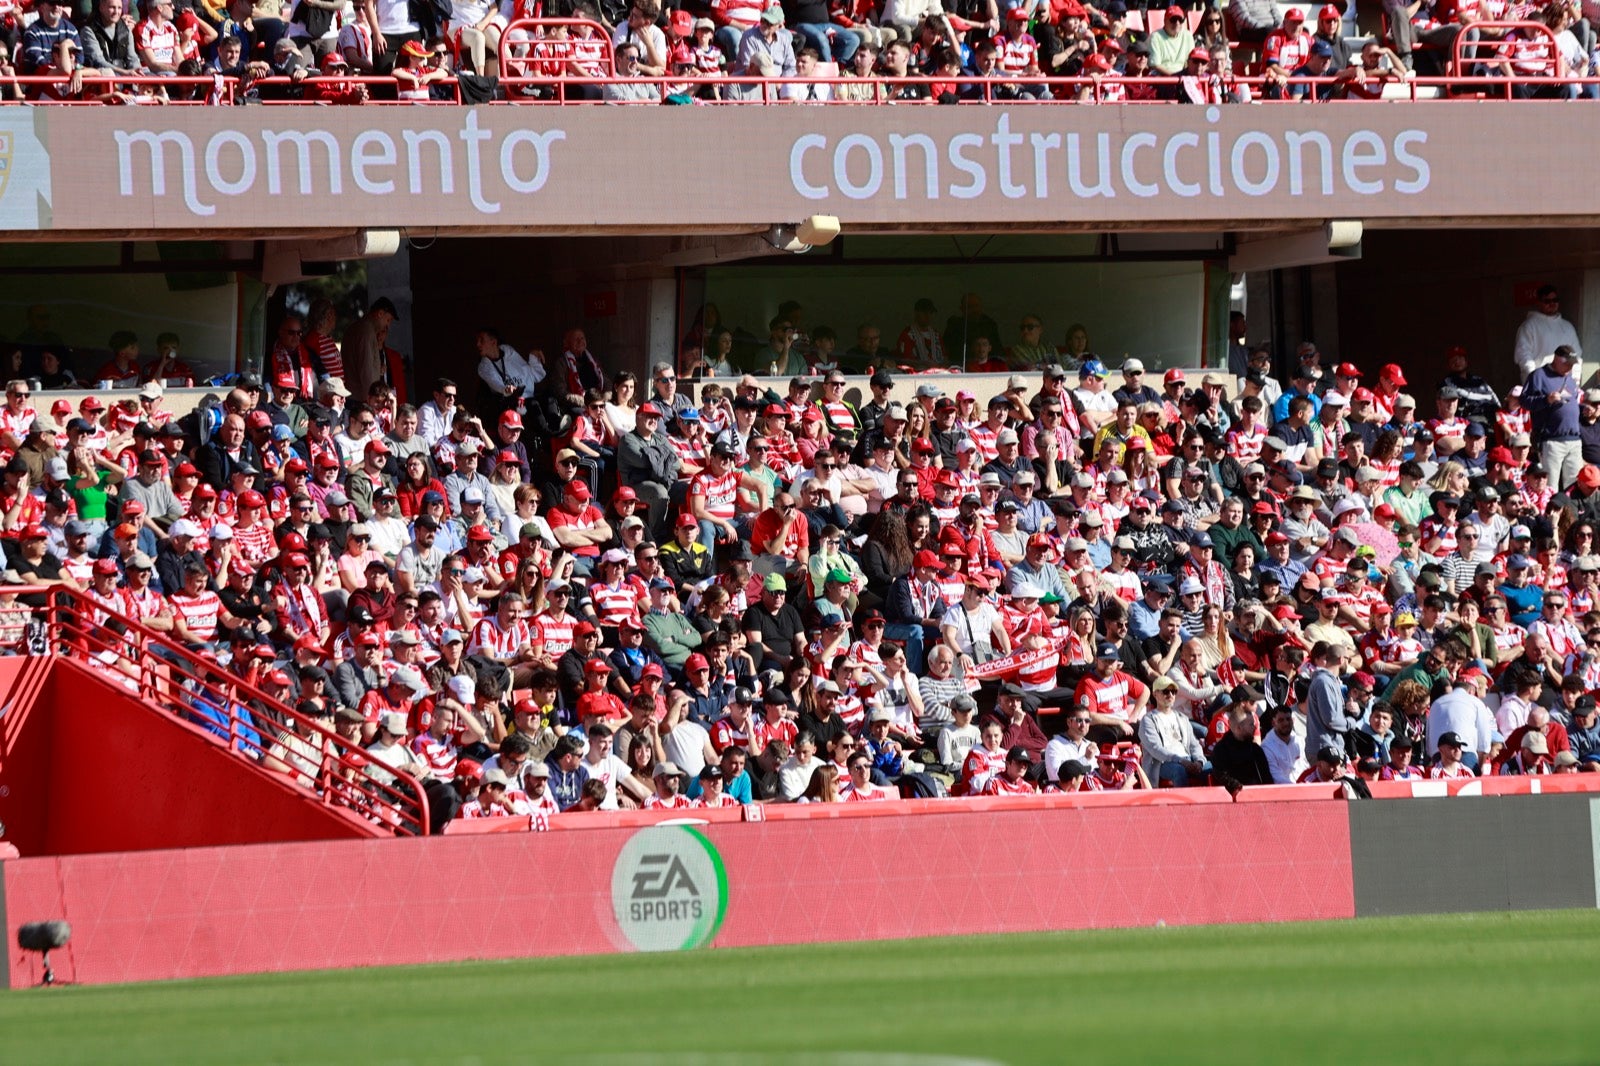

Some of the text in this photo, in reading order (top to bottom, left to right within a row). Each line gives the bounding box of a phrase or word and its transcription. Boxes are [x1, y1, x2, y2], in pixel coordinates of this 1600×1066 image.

[114, 106, 1432, 216] momento construcciones
[973, 657, 1014, 674] Granada
[630, 854, 700, 899] EA
[630, 900, 702, 921] SPORTS
